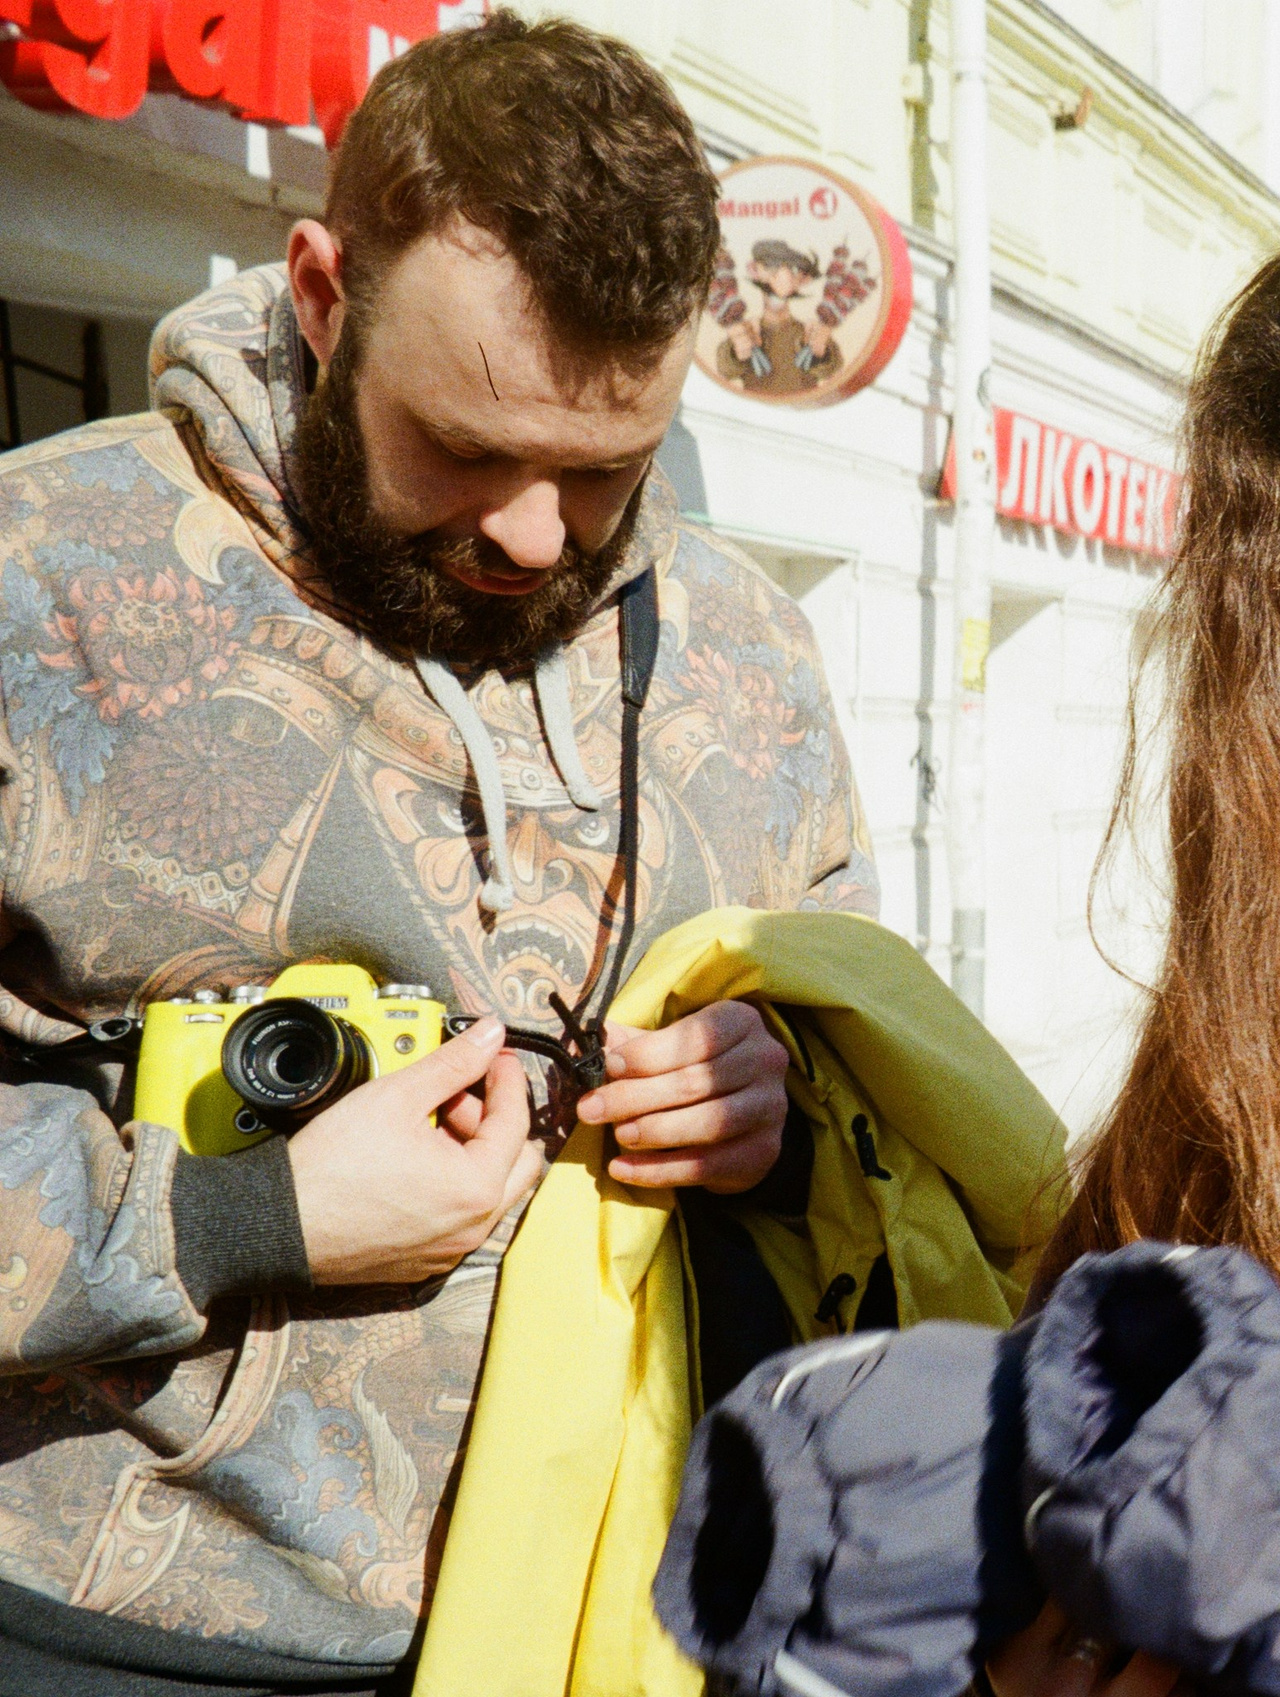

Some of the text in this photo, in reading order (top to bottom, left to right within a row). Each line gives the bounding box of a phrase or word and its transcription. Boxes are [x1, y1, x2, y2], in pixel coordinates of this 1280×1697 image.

[0, 0, 314, 127] gal
[719, 196, 800, 218] Mangal
[1001, 415, 1191, 550] ЛКОТЕК
